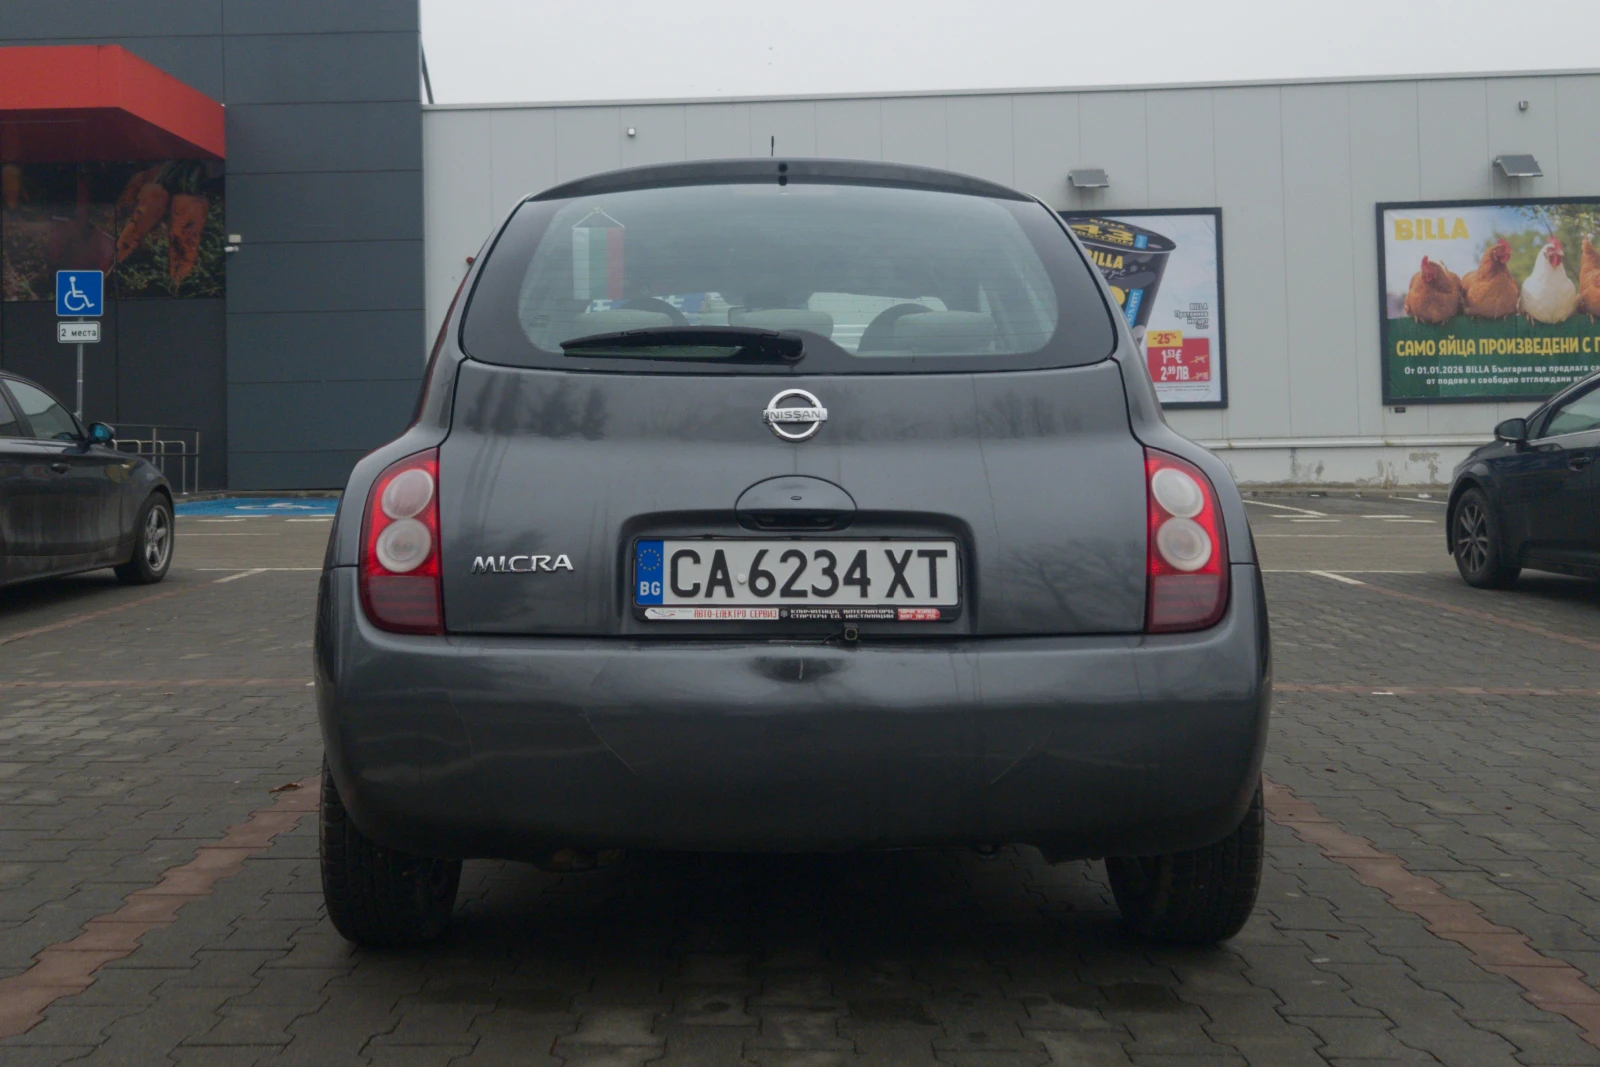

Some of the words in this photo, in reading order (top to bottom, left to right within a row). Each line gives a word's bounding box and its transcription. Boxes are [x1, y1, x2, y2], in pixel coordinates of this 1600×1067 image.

[1069, 224, 1133, 242] 43
[1395, 217, 1469, 241] BILLA
[1189, 302, 1208, 310] BILLA
[61, 328, 67, 337] 2
[71, 329, 97, 337] места
[1396, 340, 1436, 357] САМО
[1438, 334, 1476, 358] ЯЙЦА
[1479, 337, 1579, 356] ПРОИЗВЕДЕНИ
[1582, 336, 1591, 353] С
[1404, 366, 1415, 375] От
[1417, 366, 1463, 374] 01.01.2026
[1465, 365, 1489, 374] BILLA
[1492, 365, 1532, 375] България
[1535, 366, 1547, 374] ще
[1549, 365, 1589, 374] предлага
[1438, 378, 1468, 386] подово
[1478, 376, 1519, 385] свободно
[1521, 376, 1571, 384] отглеждани
[769, 410, 820, 419] NISSAN
[471, 554, 574, 573] MICRA
[670, 549, 735, 598] CA
[748, 549, 871, 598] 6234
[884, 549, 948, 598] XT
[640, 581, 660, 596] BG
[694, 609, 746, 619] АВТО-ЕЛЕКТРО
[749, 609, 777, 619] СЕРВИЗ
